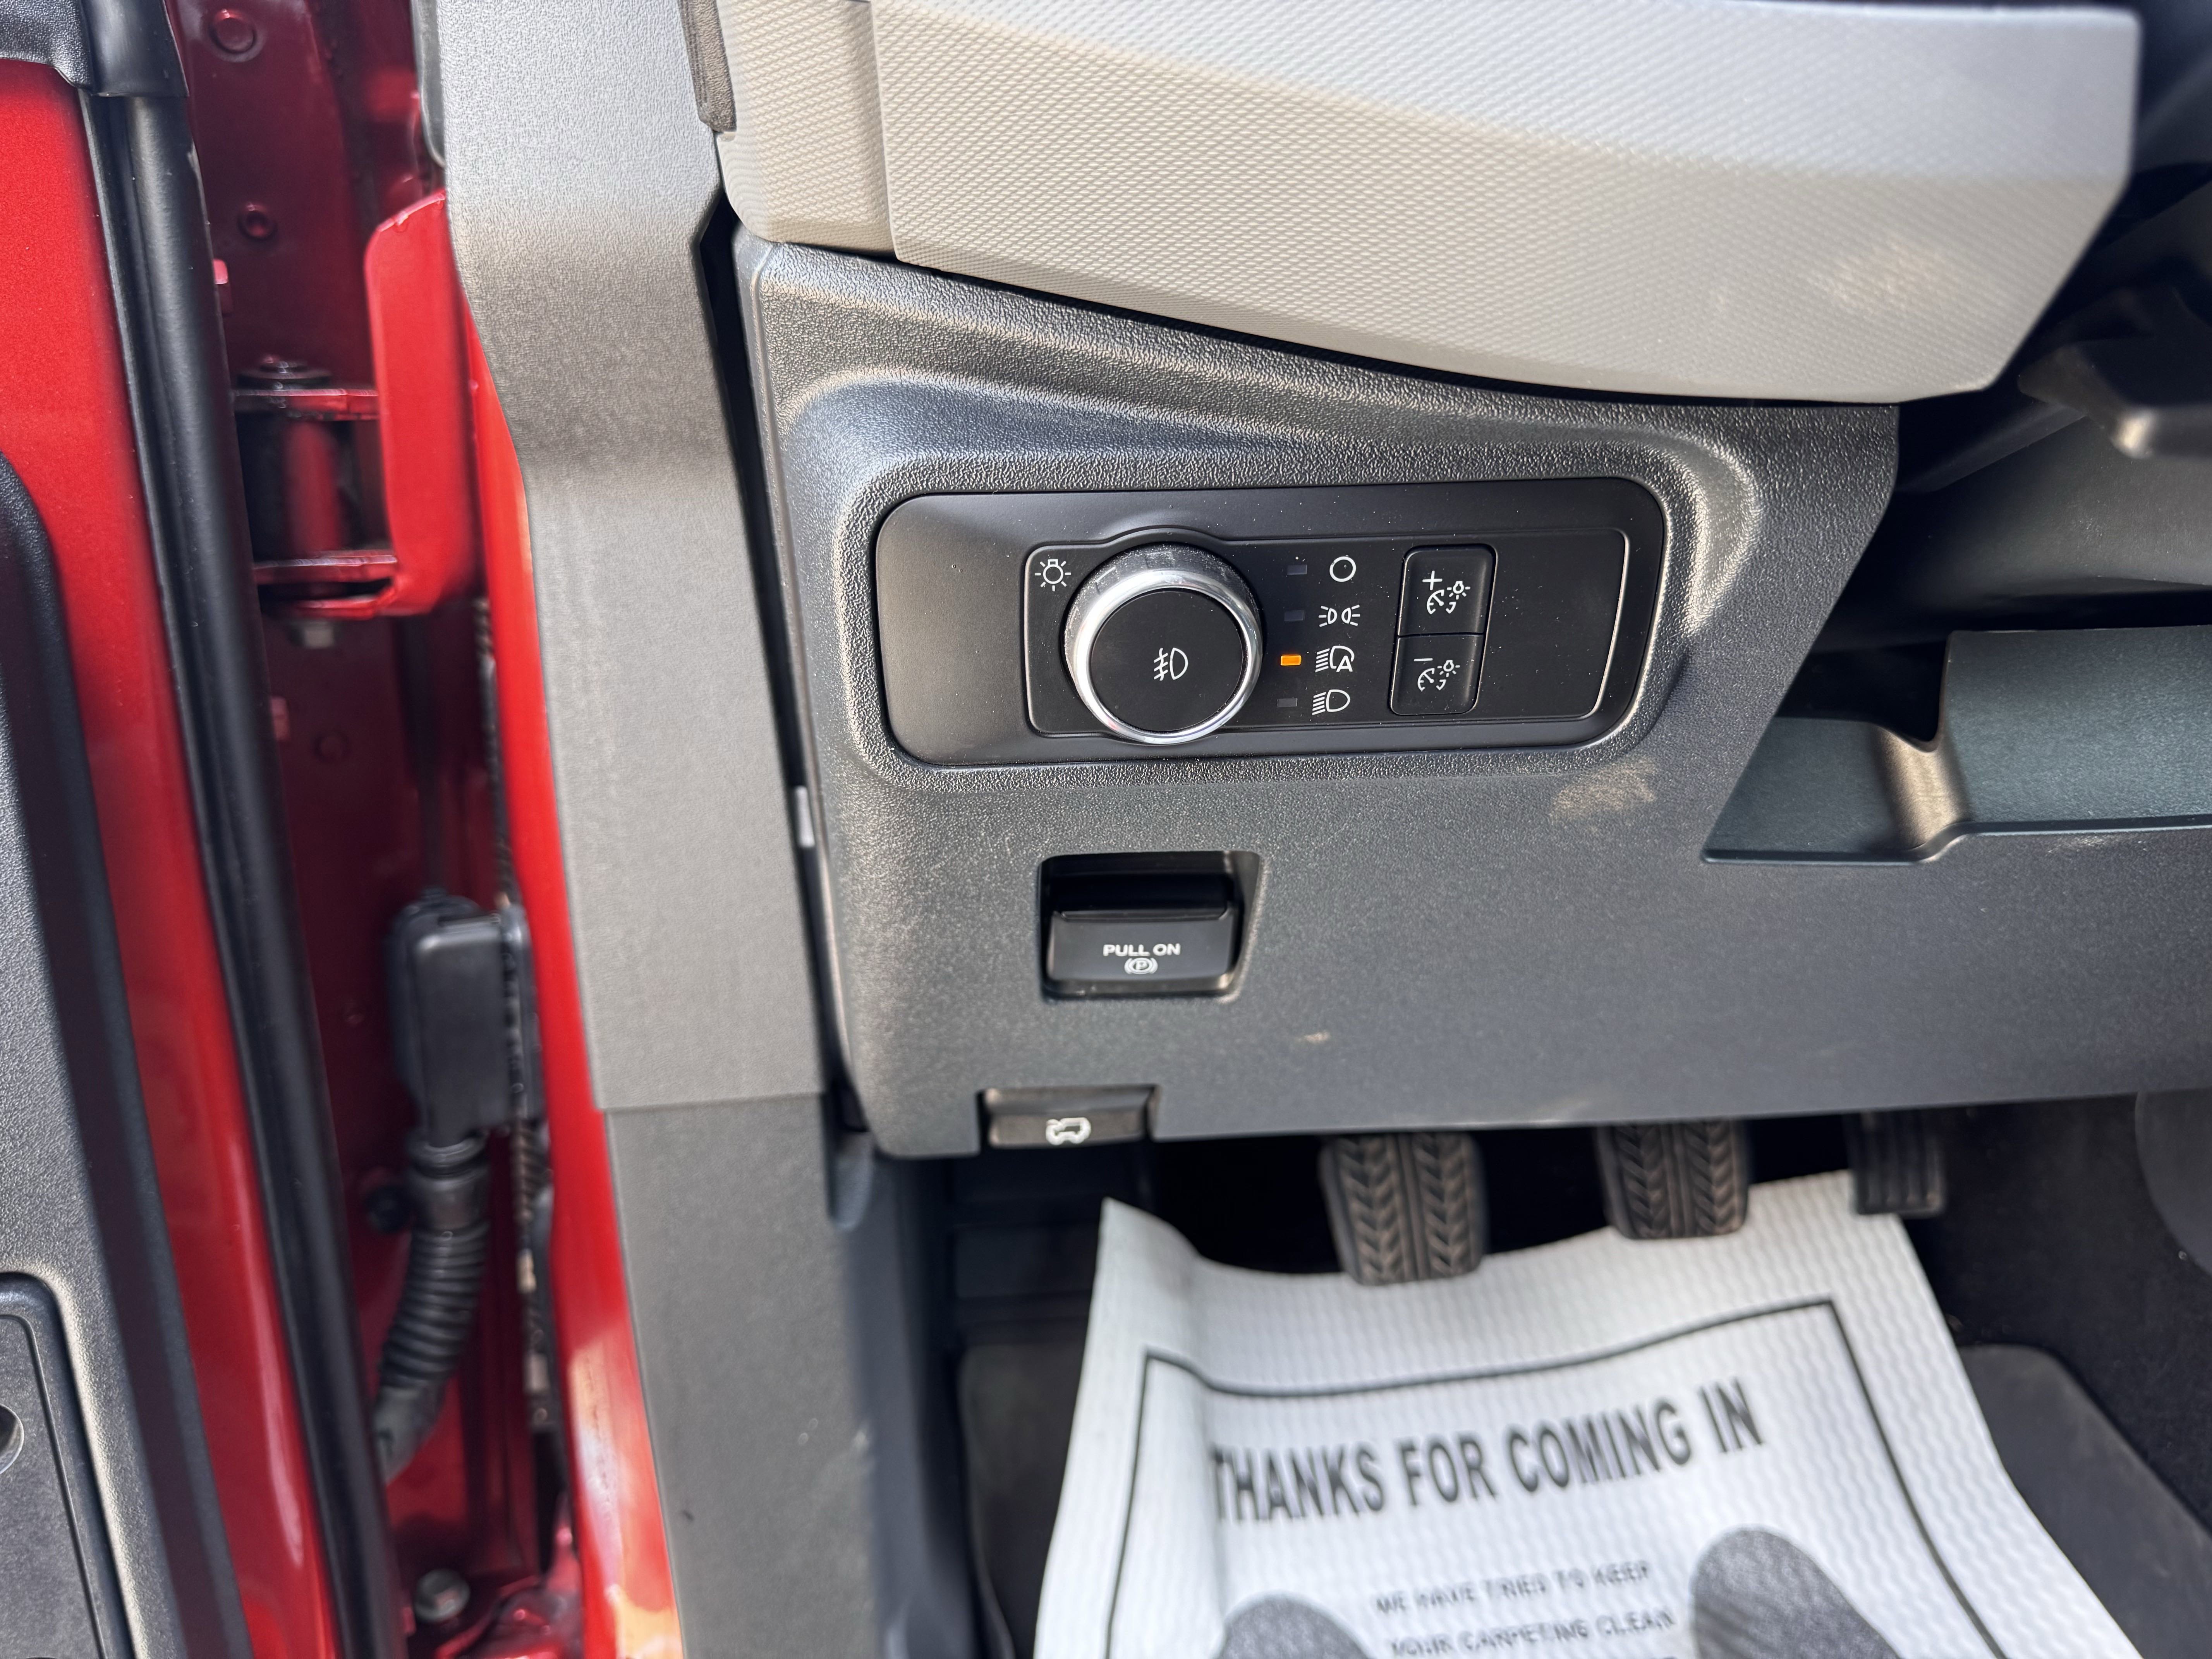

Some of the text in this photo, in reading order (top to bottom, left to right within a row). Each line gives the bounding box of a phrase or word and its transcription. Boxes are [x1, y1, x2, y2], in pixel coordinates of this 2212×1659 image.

[1103, 943, 1181, 957] PULL ON
[1210, 1376, 1763, 1520] THANKS FOR COMING IN
[1373, 1560, 1650, 1614] WE HAVE TRIED TO KEEP
[1391, 1607, 1675, 1657] YOUR CARPETING CLEAN
